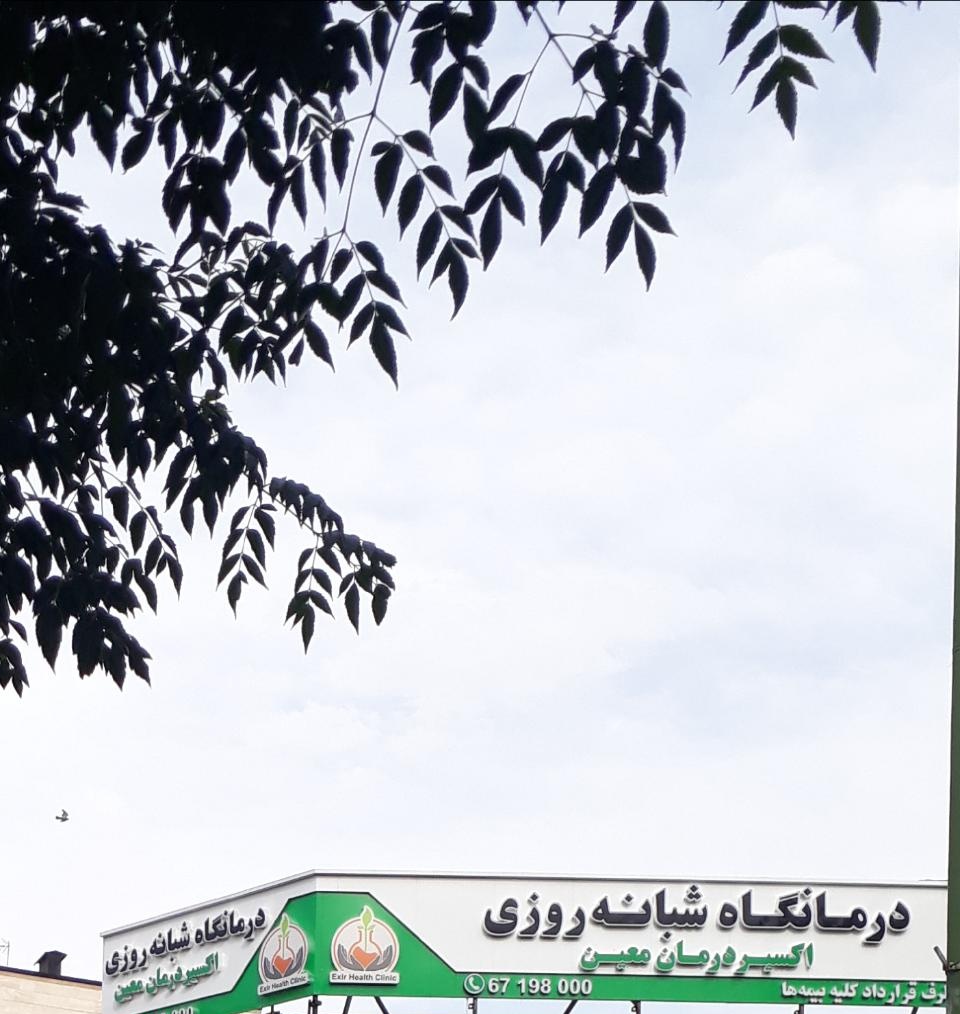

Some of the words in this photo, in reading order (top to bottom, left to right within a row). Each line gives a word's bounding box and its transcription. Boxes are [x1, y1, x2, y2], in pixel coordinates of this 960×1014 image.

[194, 907, 266, 945] درمانگاه
[483, 892, 586, 937] روزی
[592, 884, 708, 940] شبانه
[718, 887, 911, 943] درمانگاه
[149, 921, 191, 962] شبانه
[656, 940, 736, 973] درمان
[105, 945, 147, 975] روزی
[184, 952, 219, 986] اکسیر
[579, 946, 652, 972] معین
[734, 942, 814, 974] اکسیر
[114, 979, 143, 1002] معین
[145, 966, 184, 994] درمان
[271, 980, 289, 990] Health
[289, 975, 307, 985] Clinic
[348, 973, 374, 981] Health
[375, 973, 397, 982] Clinic
[488, 977, 511, 994] 67
[517, 977, 552, 995] 198
[557, 978, 593, 995] 000
[830, 981, 859, 1003] کلیه
